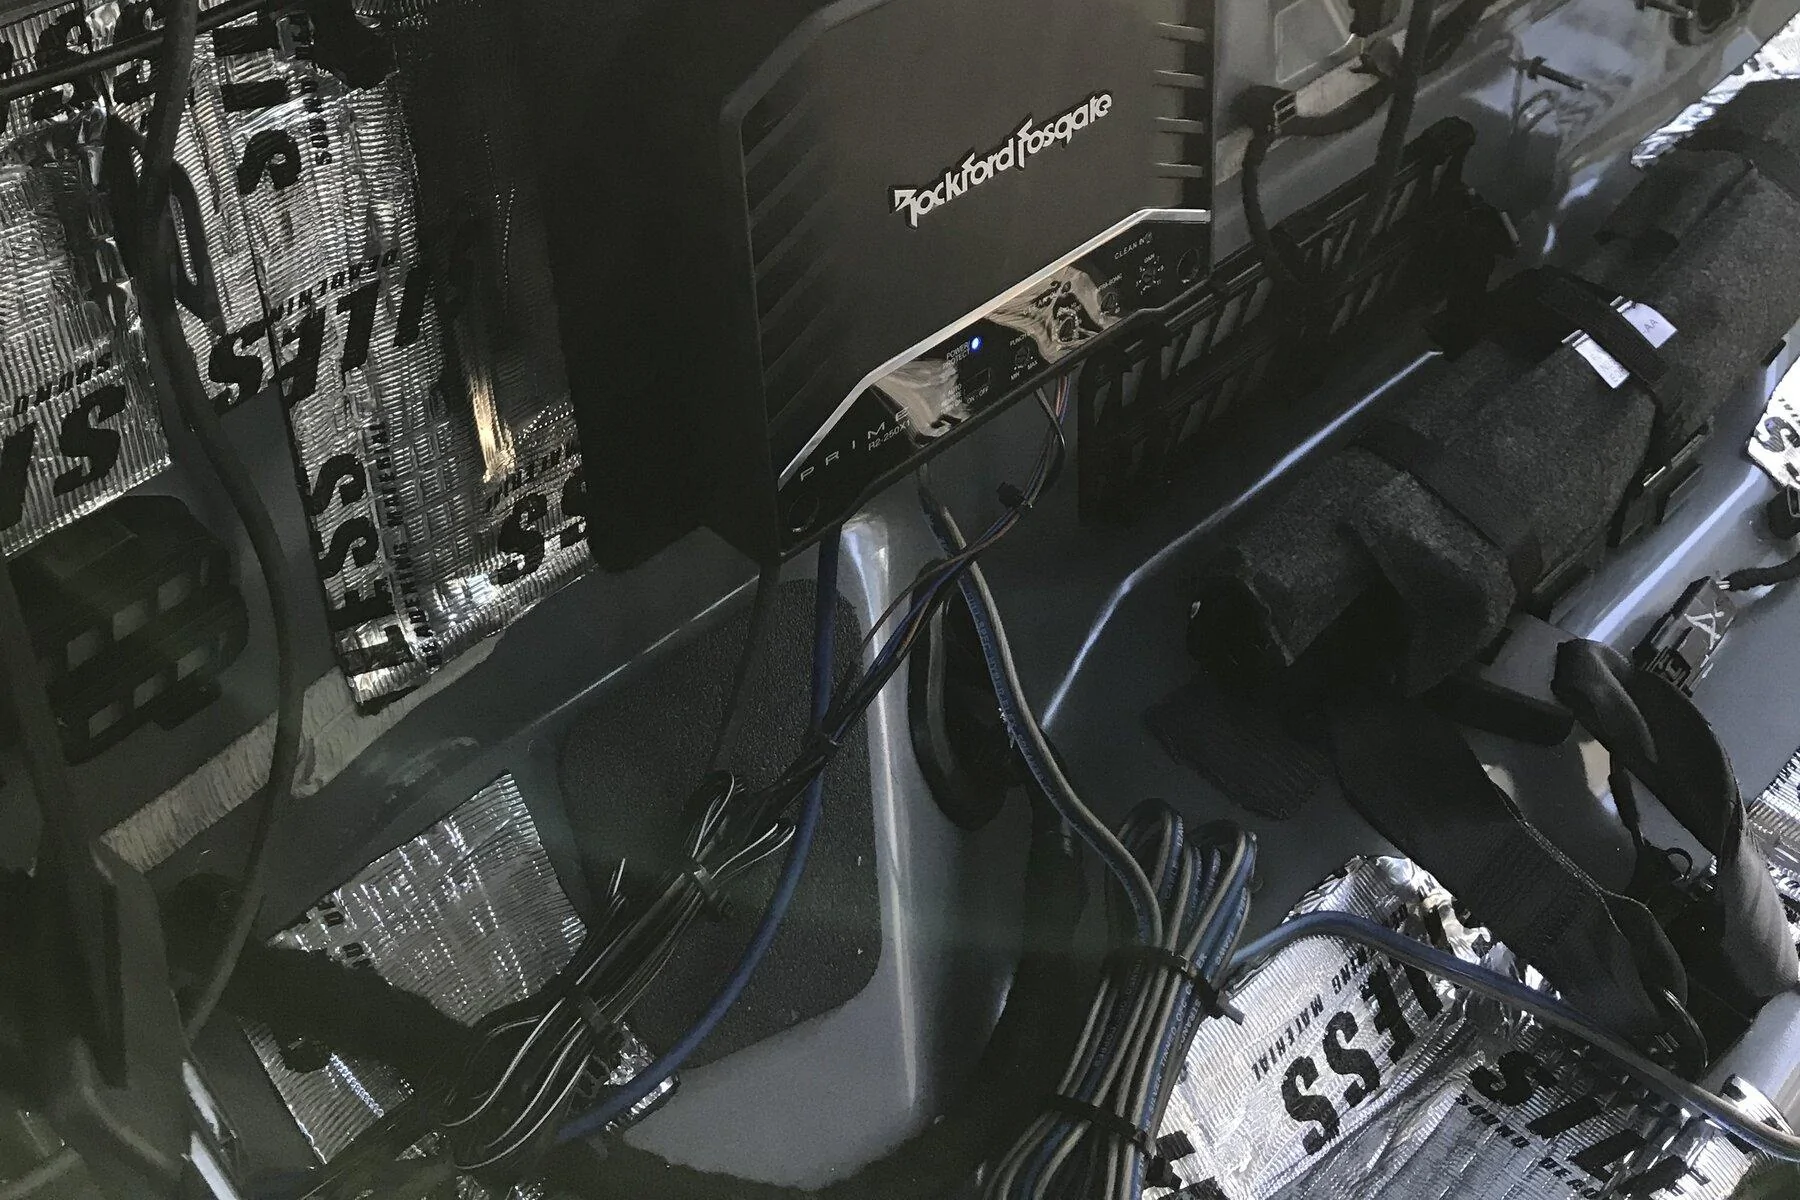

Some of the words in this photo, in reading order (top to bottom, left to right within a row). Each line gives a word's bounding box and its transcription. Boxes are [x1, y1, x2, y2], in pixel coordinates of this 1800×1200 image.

[894, 137, 1015, 228] Rockford
[800, 406, 909, 482] PRIME
[1252, 994, 1325, 1083] MATERIAL
